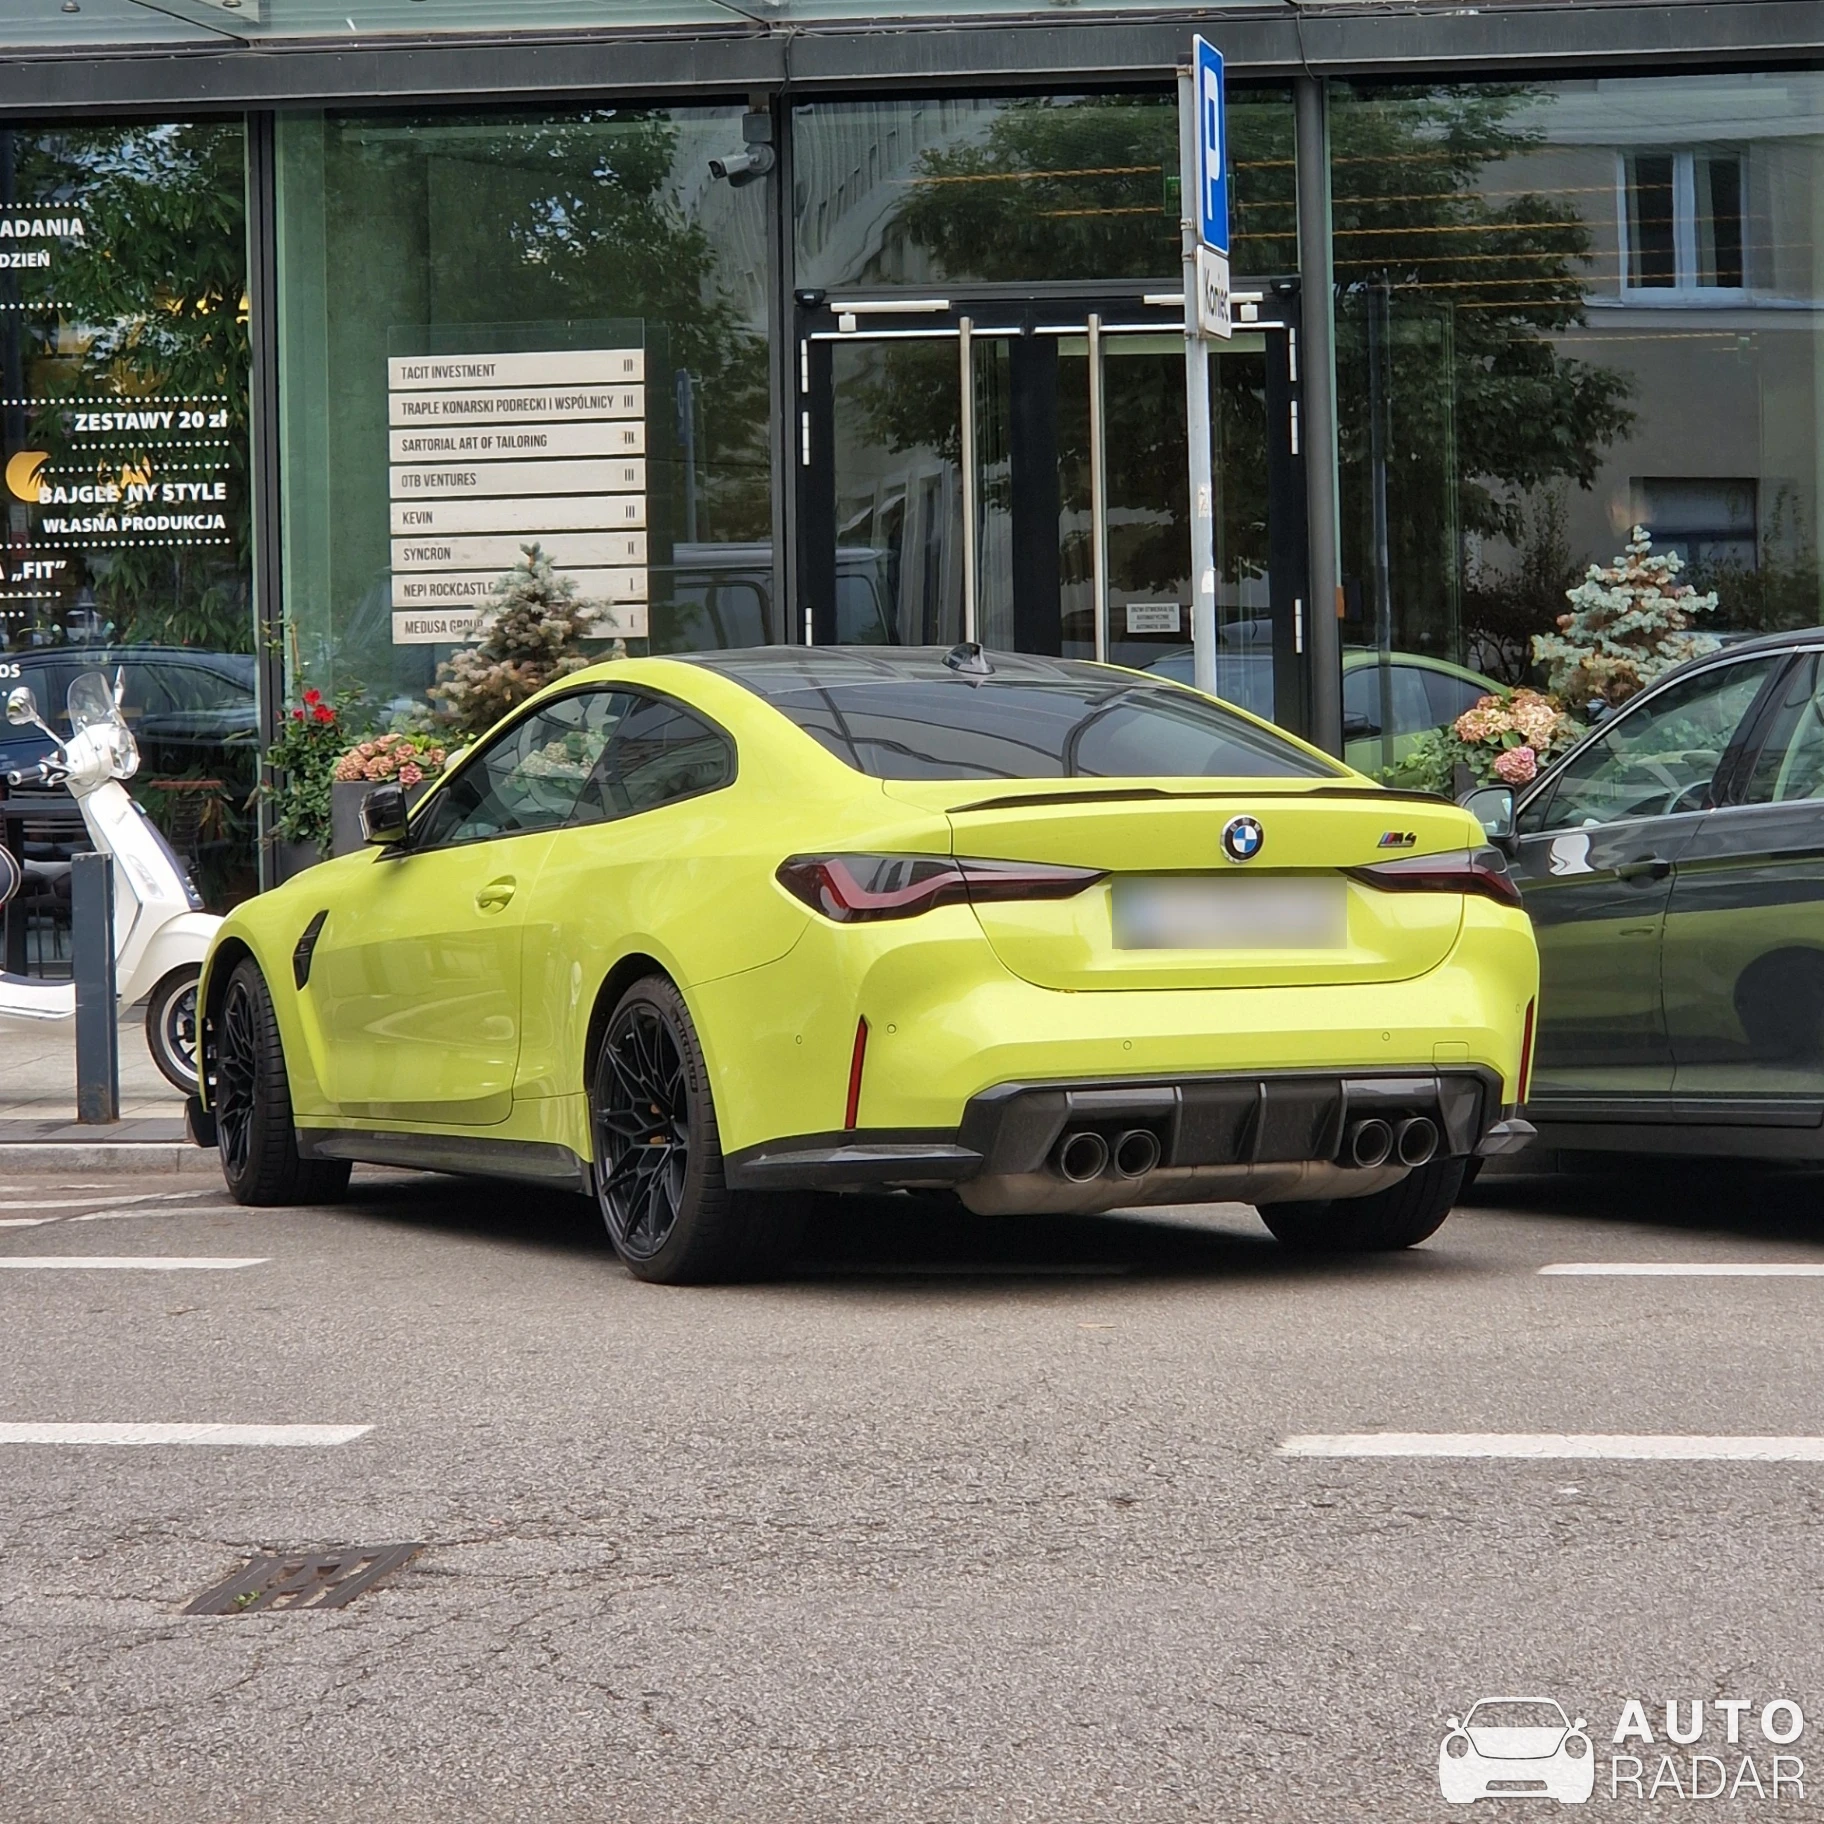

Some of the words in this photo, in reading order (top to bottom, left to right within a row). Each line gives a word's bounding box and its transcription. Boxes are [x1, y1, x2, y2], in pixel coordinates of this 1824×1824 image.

[0, 218, 84, 237] ADANIA
[0, 249, 50, 268] DZIEŃ
[401, 366, 429, 380] TACIT
[432, 363, 496, 378] INVESTMENT
[624, 359, 633, 372] III
[402, 400, 440, 415] TRAPLE
[443, 397, 494, 414] KONARSKI
[497, 396, 547, 412] PODRECKI
[556, 393, 614, 409] WSPÓLNICY
[624, 395, 634, 408] III
[75, 411, 174, 431] ZESTAWY
[179, 411, 204, 429] 20
[209, 409, 228, 428] zł
[402, 436, 457, 452] SARTORIAL
[459, 436, 478, 449] ART
[481, 435, 493, 449] OF
[497, 434, 548, 448] TAILORING
[625, 431, 635, 445] III
[402, 474, 421, 488] OTB
[424, 472, 477, 487] VENTURES
[625, 468, 635, 482] III
[127, 483, 157, 501] NY
[162, 482, 227, 501] STYLE
[43, 518, 118, 533] WŁASNA
[121, 514, 226, 531] PRODUKCJA
[402, 511, 433, 525] KEVIN
[626, 505, 636, 519] III
[403, 547, 451, 561] SYNCRON
[628, 541, 635, 554] II
[404, 583, 427, 597] NEPI
[405, 620, 447, 635] MEDUSA
